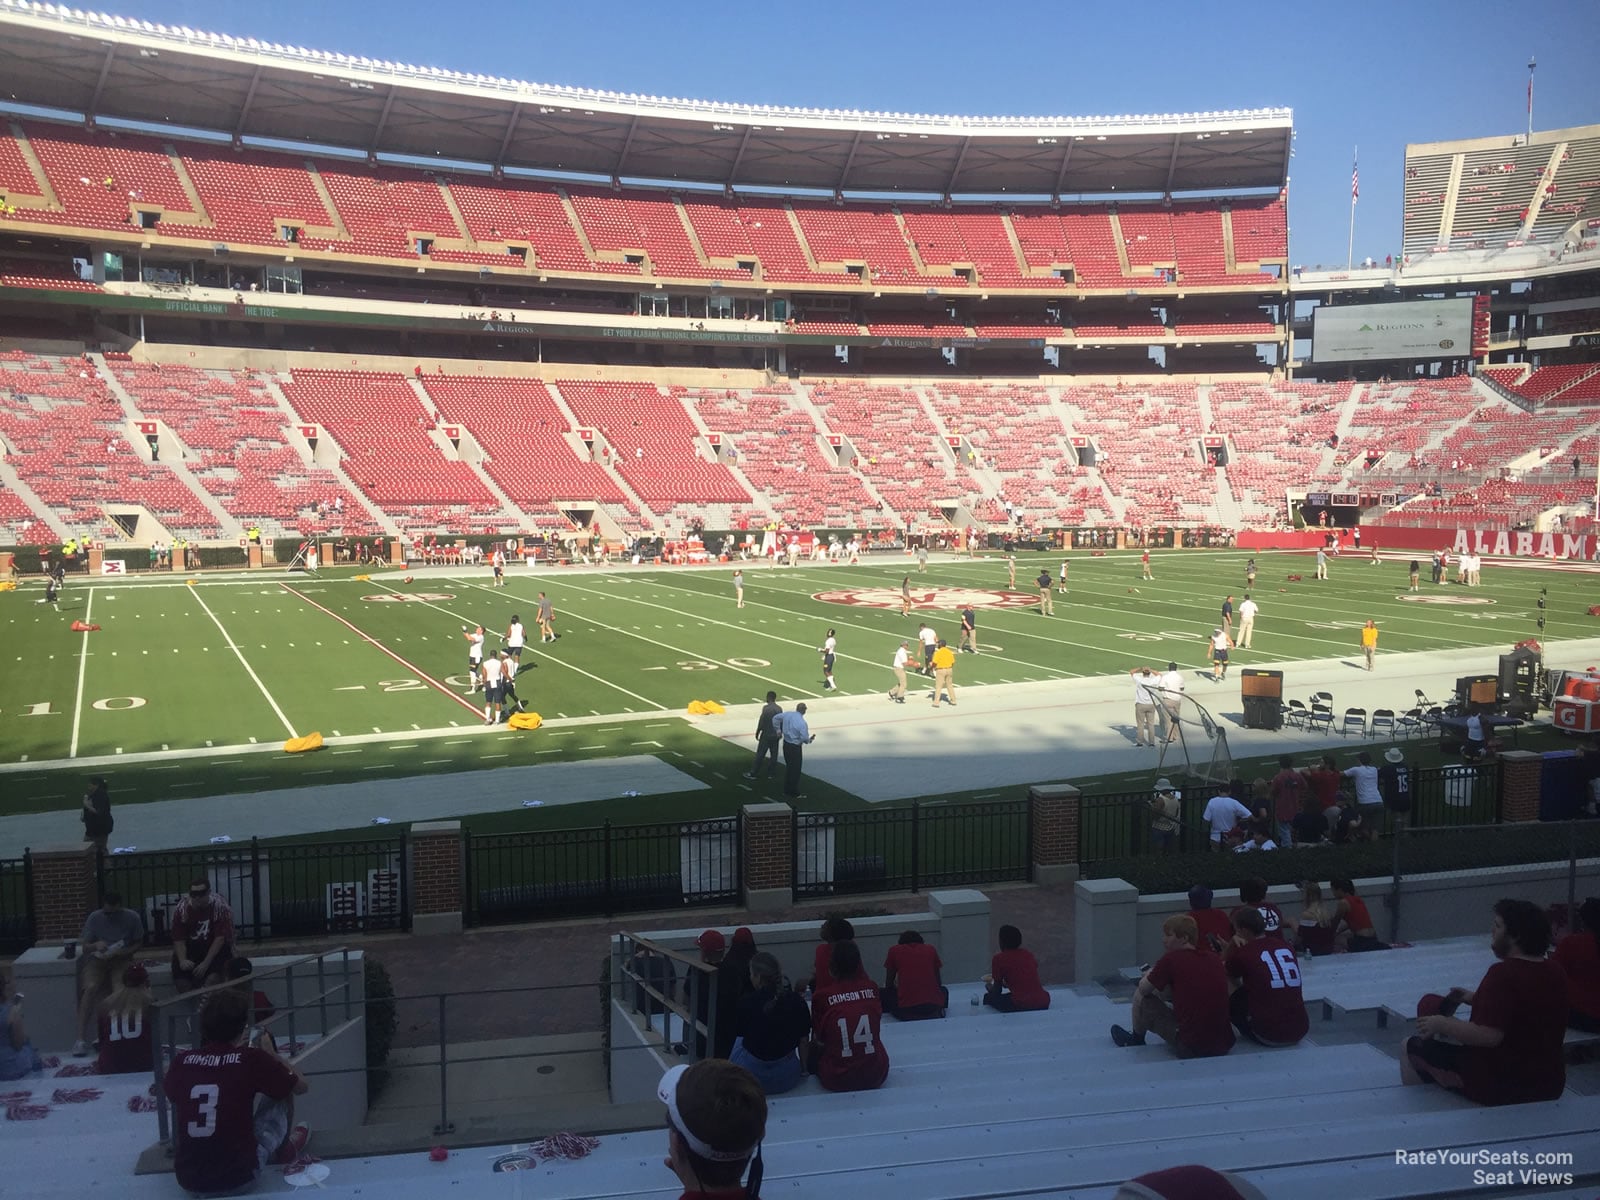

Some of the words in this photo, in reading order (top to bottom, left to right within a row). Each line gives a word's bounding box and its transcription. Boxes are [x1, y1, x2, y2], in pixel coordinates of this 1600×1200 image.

[166, 302, 201, 312] OFFICIAL
[1376, 323, 1425, 331] REGIONS
[1453, 529, 1600, 560] ALABAM
[1397, 775, 1408, 792] 15
[1260, 948, 1302, 989] 16
[827, 991, 860, 1005] CRIMSON
[860, 988, 876, 999] TIDE
[109, 1006, 143, 1042] 10
[837, 1014, 876, 1057] 14
[183, 1055, 220, 1067] CRIMSON
[222, 1053, 242, 1065] TIDE
[187, 1084, 220, 1138] 3
